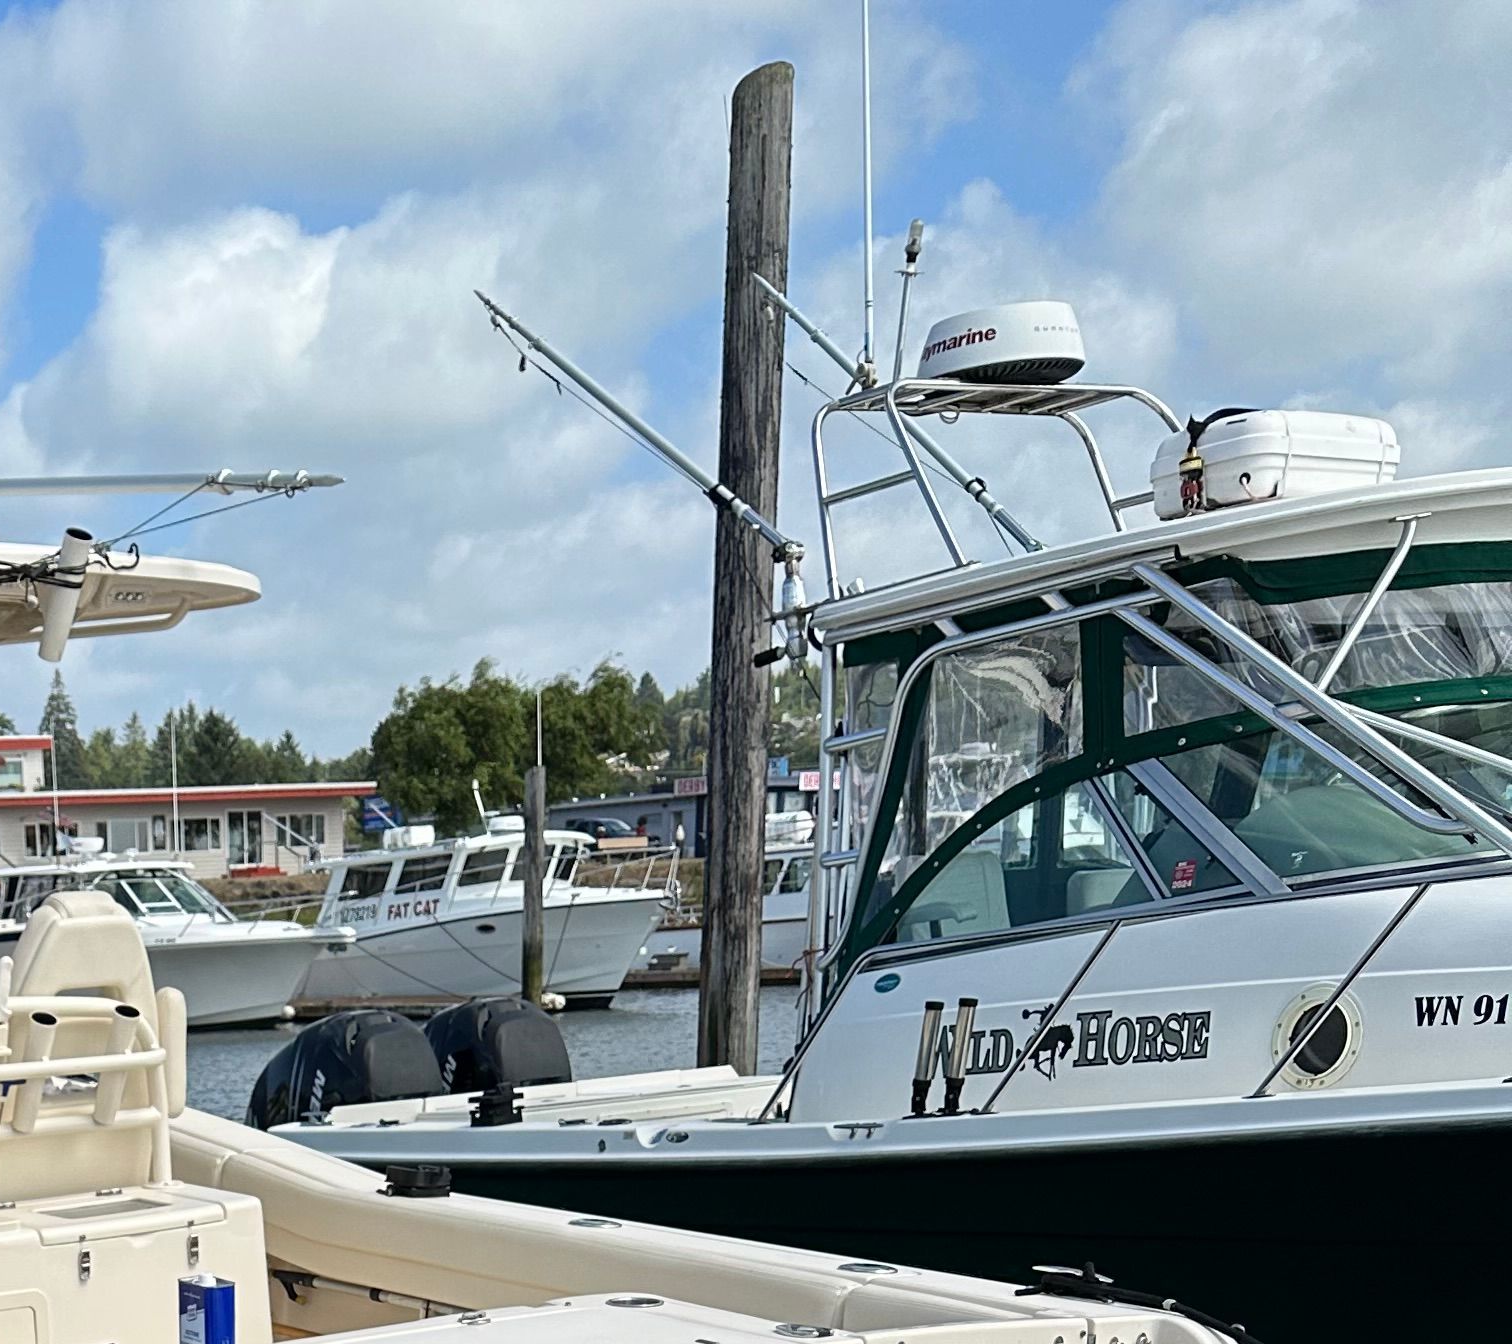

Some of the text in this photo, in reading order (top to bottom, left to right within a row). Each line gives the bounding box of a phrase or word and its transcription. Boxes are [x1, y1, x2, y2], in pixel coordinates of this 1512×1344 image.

[388, 902, 410, 921] FAT
[414, 898, 440, 916] CAT
[1414, 993, 1509, 1027] WN 91
[1072, 1009, 1212, 1068] HORSE
